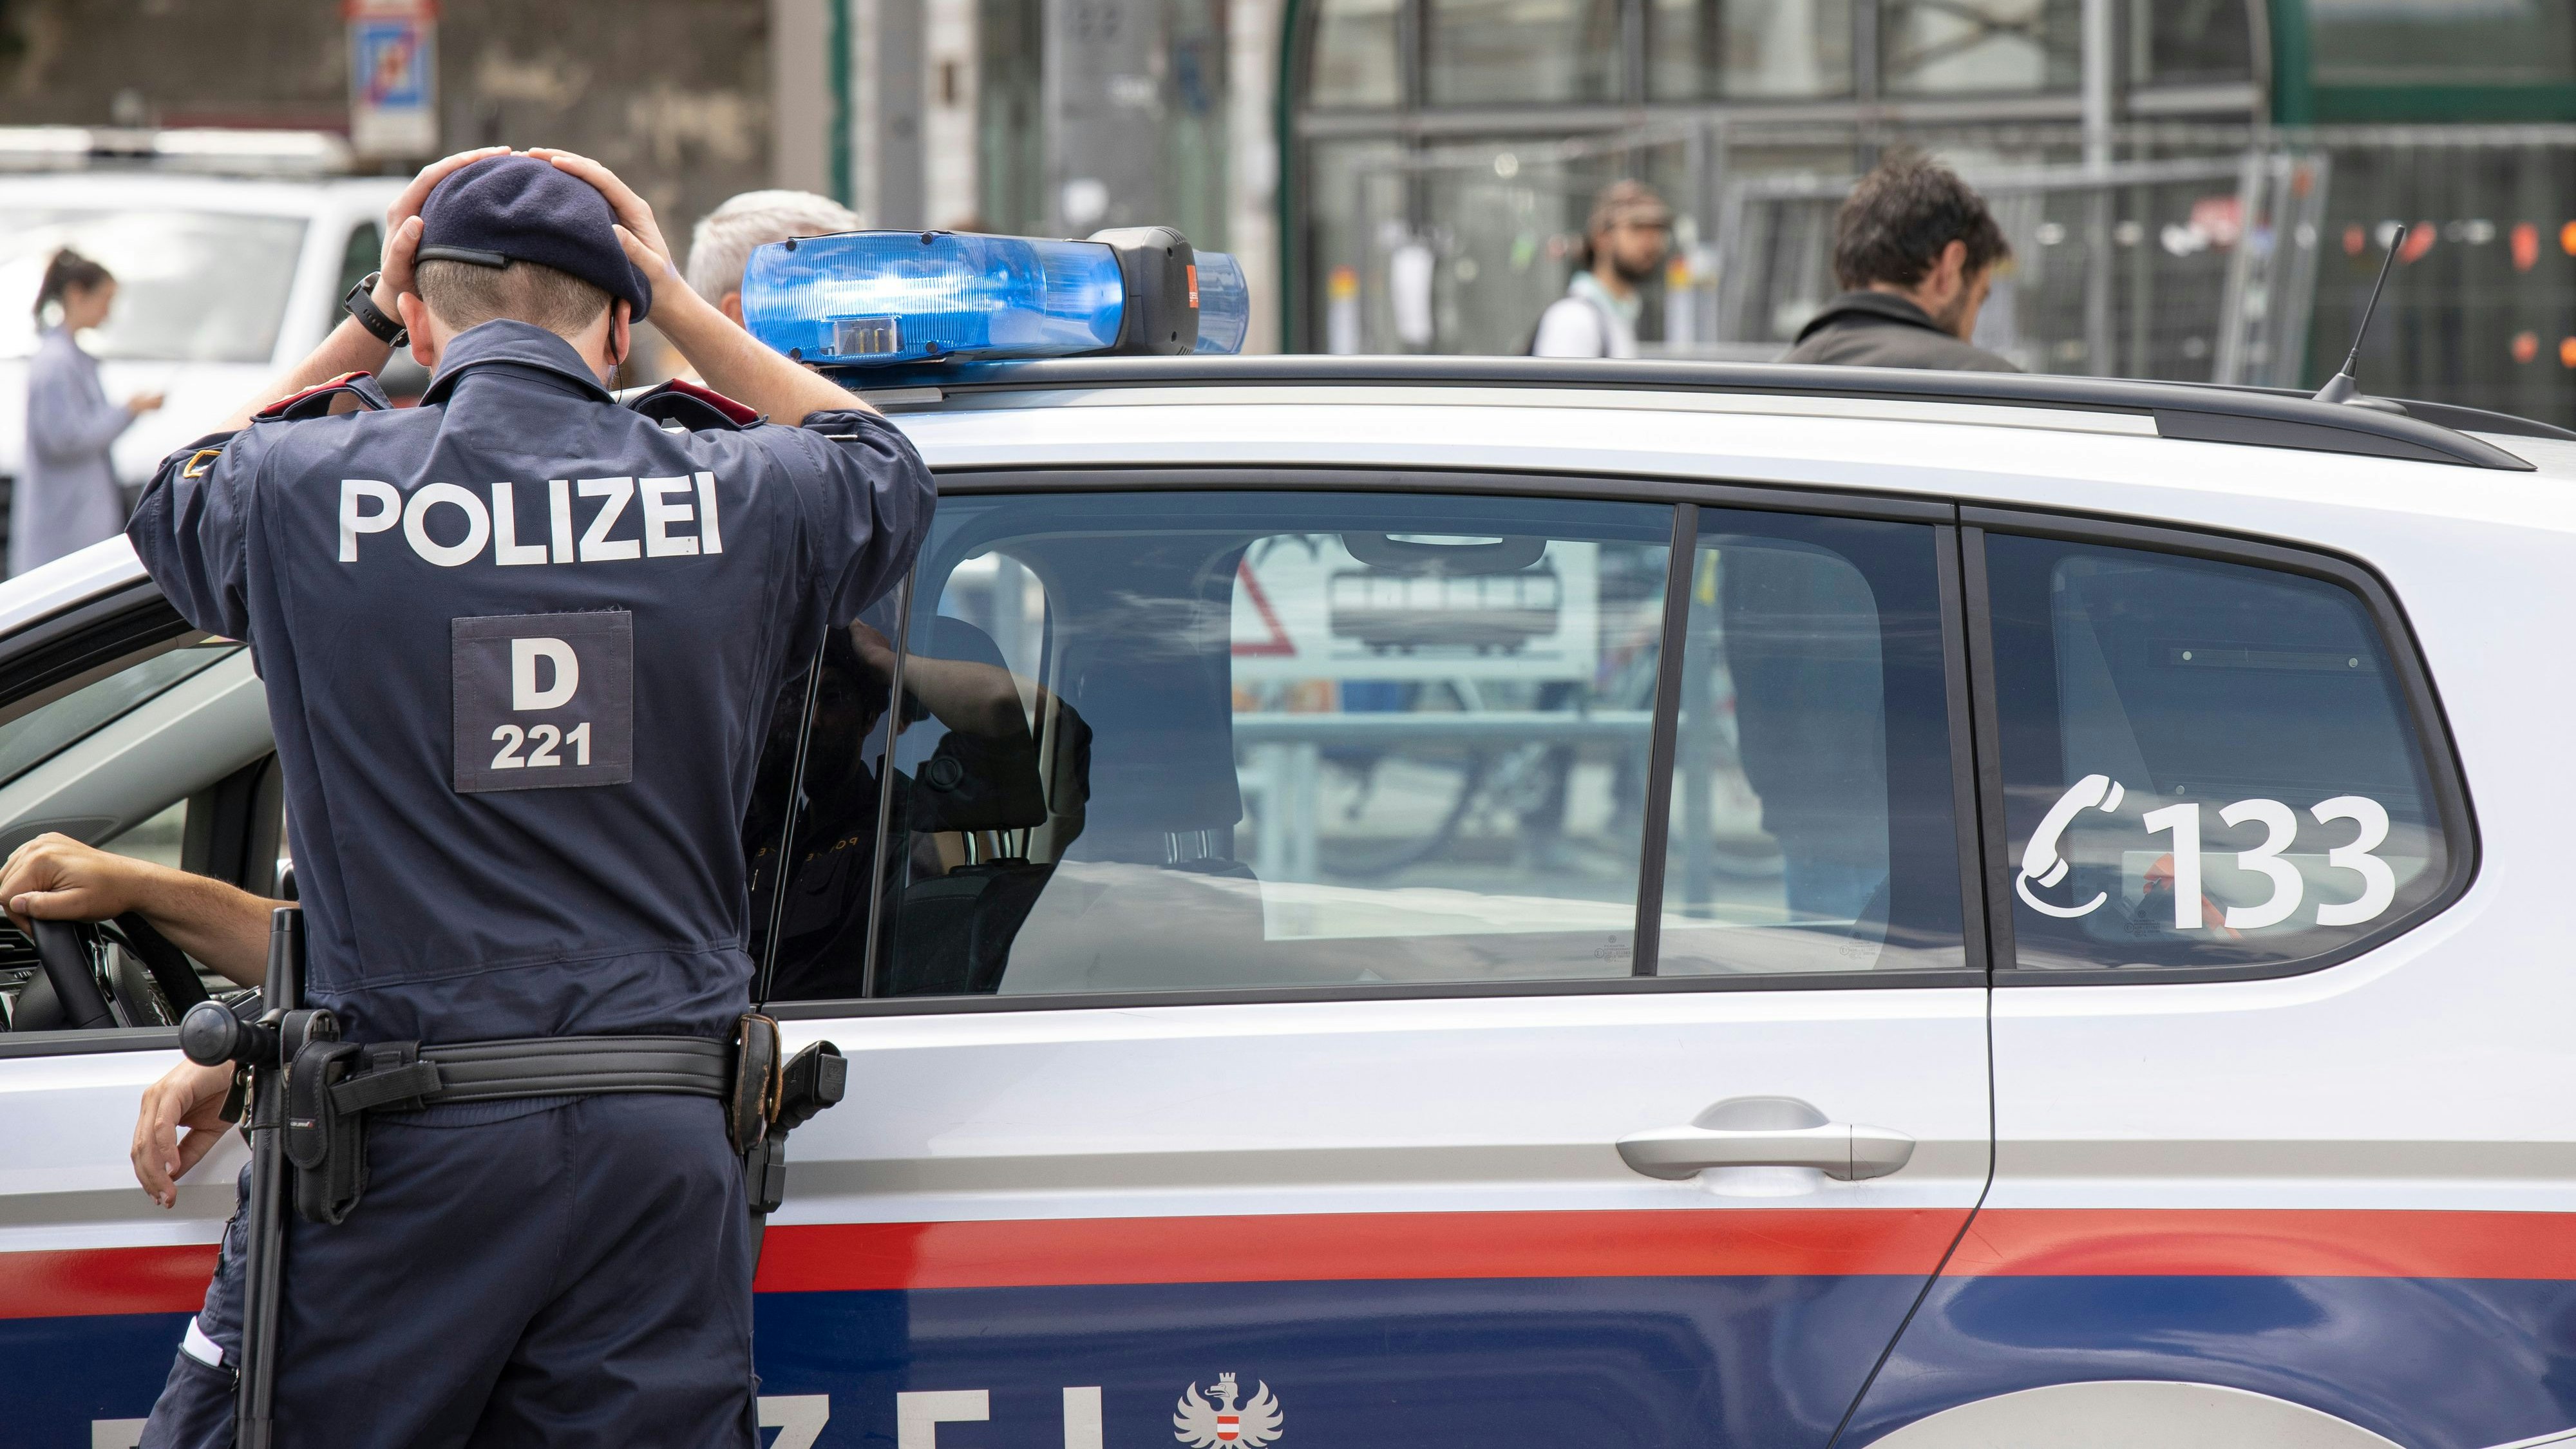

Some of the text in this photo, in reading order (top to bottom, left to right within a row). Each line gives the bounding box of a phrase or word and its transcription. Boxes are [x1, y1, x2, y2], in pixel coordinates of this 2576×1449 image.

[339, 471, 723, 567] POLIZEI
[512, 638, 579, 711] D
[491, 722, 591, 770] 221
[2143, 795, 2396, 929] 133
